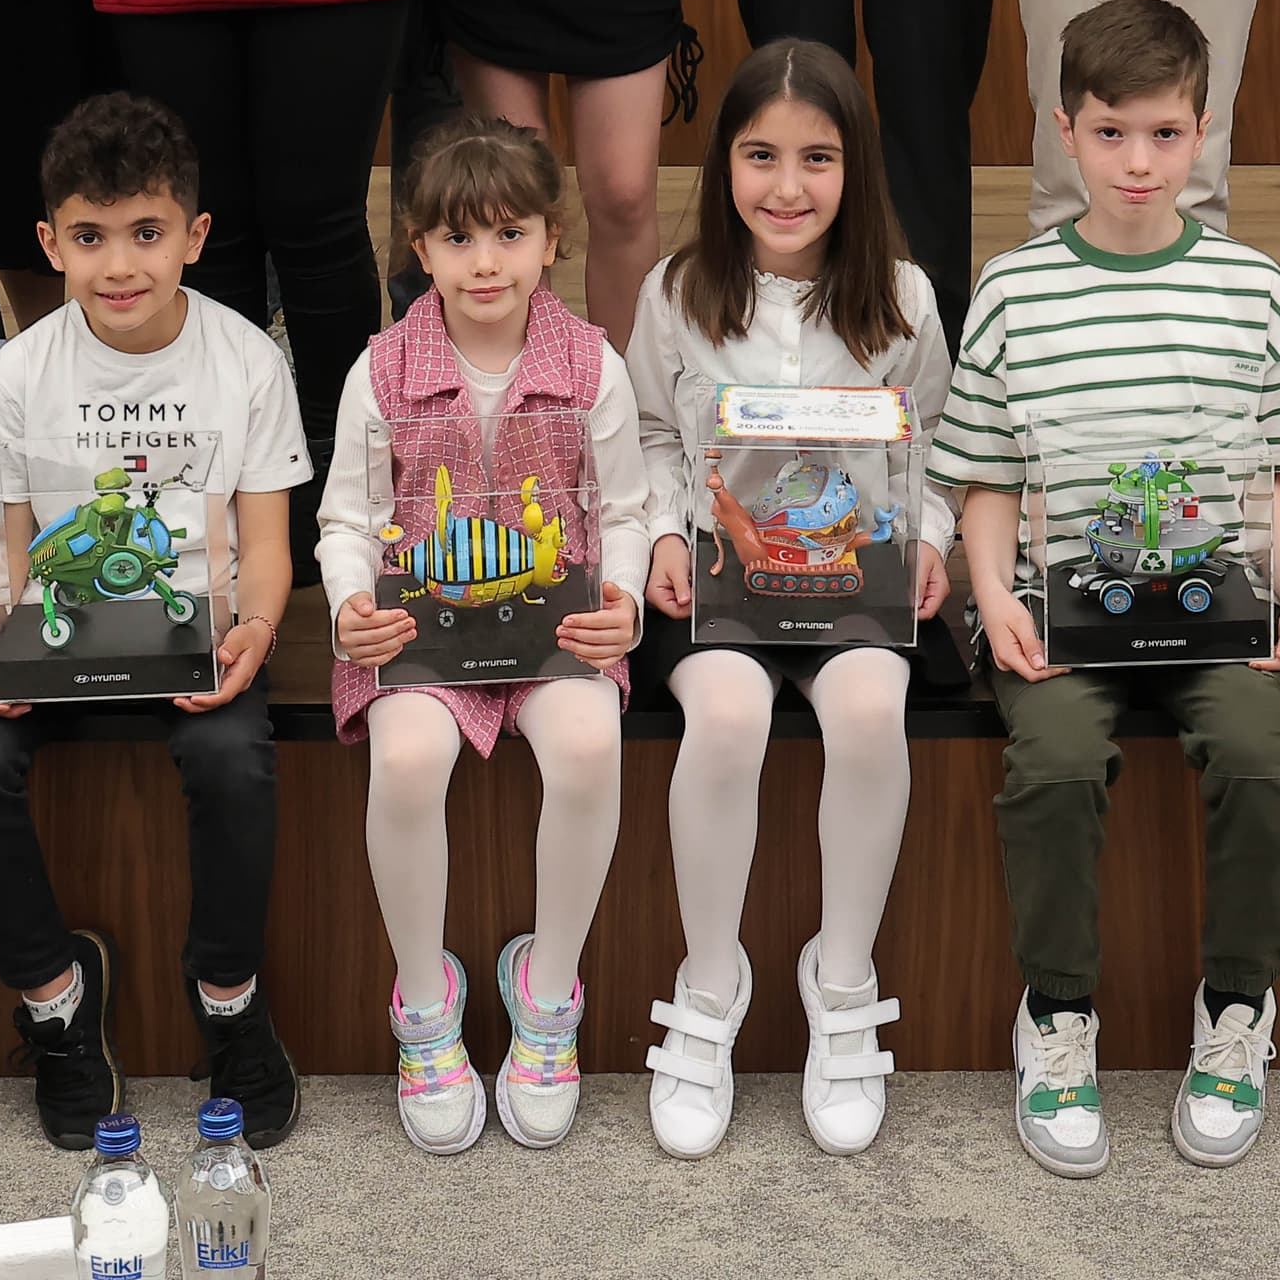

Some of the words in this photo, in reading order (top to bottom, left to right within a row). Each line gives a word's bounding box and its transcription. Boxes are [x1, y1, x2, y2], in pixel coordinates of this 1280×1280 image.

[78, 403, 187, 422] TOMMY
[76, 431, 197, 448] HILFIGER
[795, 622, 833, 630] HYUNDAI
[1148, 639, 1187, 647] HYUNDAI
[479, 658, 517, 667] HYUNDAI
[91, 673, 130, 682] HYUNDAI
[1216, 1082, 1236, 1094] NIKE
[1058, 1091, 1077, 1103] NKE
[197, 1240, 249, 1261] Erikli
[91, 1254, 143, 1275] Erikli
